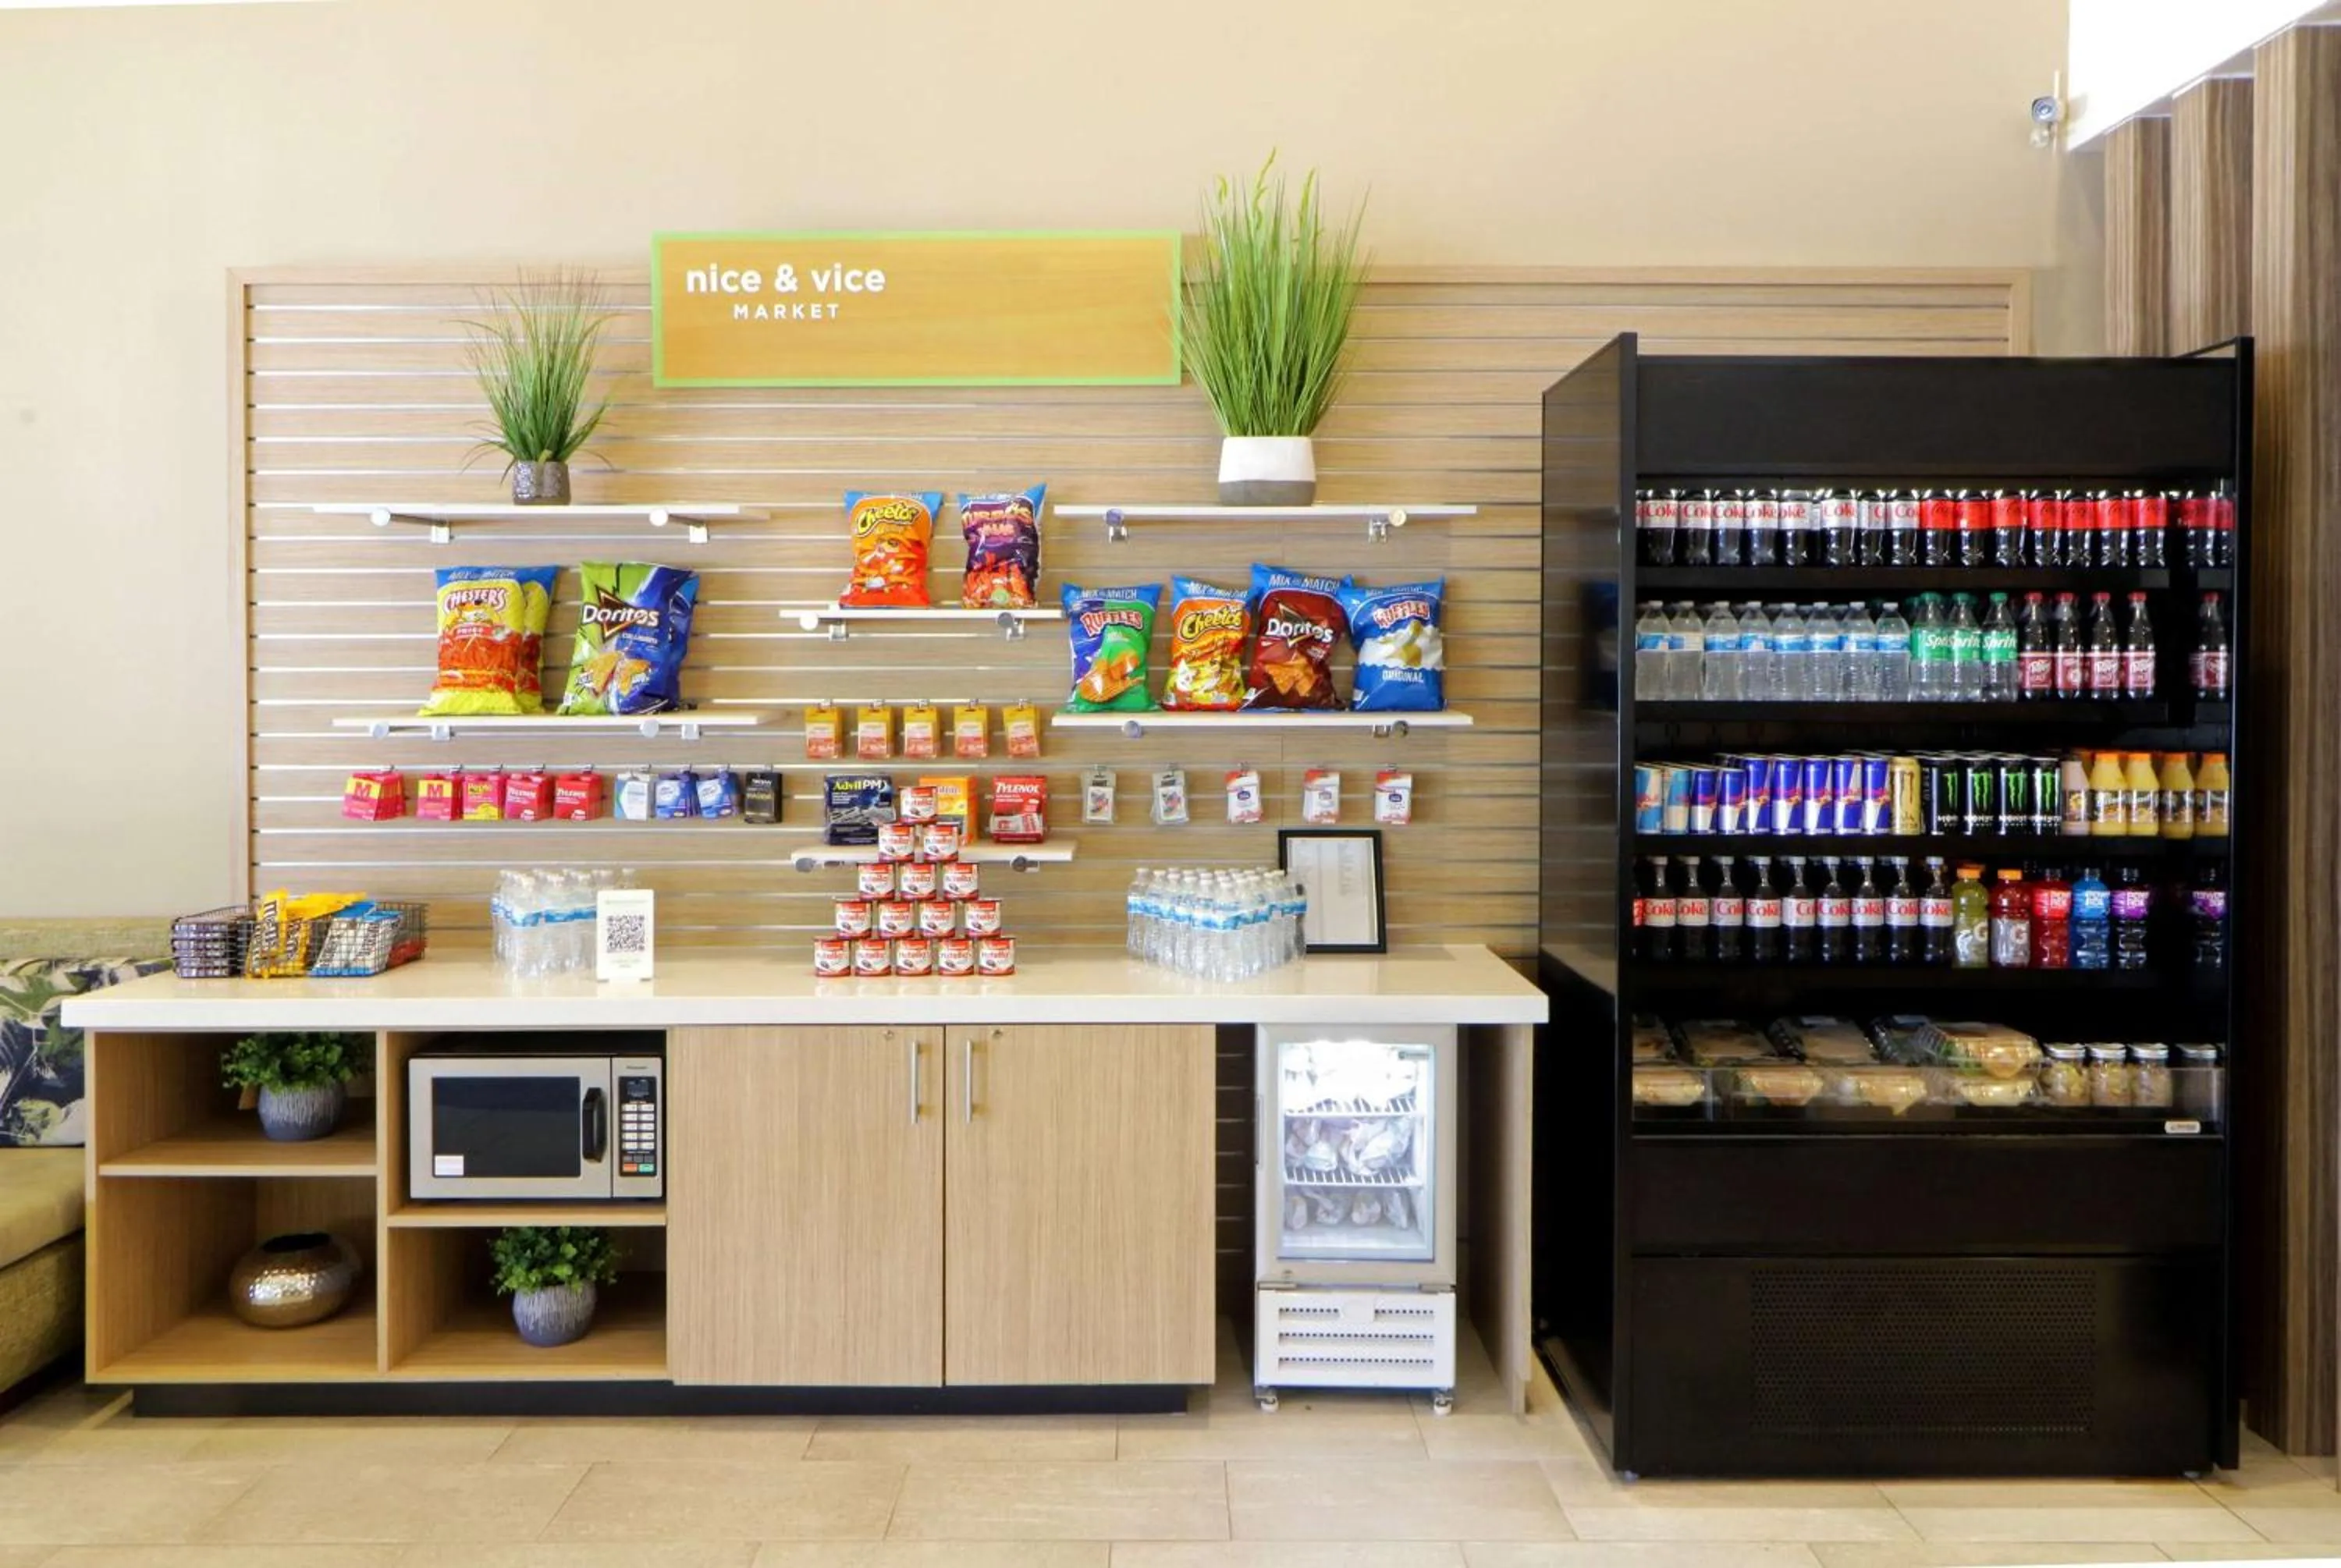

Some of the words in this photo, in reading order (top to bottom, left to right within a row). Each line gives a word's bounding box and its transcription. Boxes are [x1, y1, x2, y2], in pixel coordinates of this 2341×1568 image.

[686, 263, 762, 293] nice
[775, 264, 798, 293] &
[812, 263, 886, 292] vice
[734, 303, 839, 319] MARKET
[443, 588, 508, 614] CHESTER'S
[582, 605, 660, 626] Doritos
[1080, 612, 1143, 637] RUFFLES
[1373, 601, 1430, 629] RUFFLES
[1266, 618, 1334, 643] Doritos
[833, 781, 862, 791] Advil
[863, 779, 881, 790] PM
[996, 782, 1040, 794] TYLENOL
